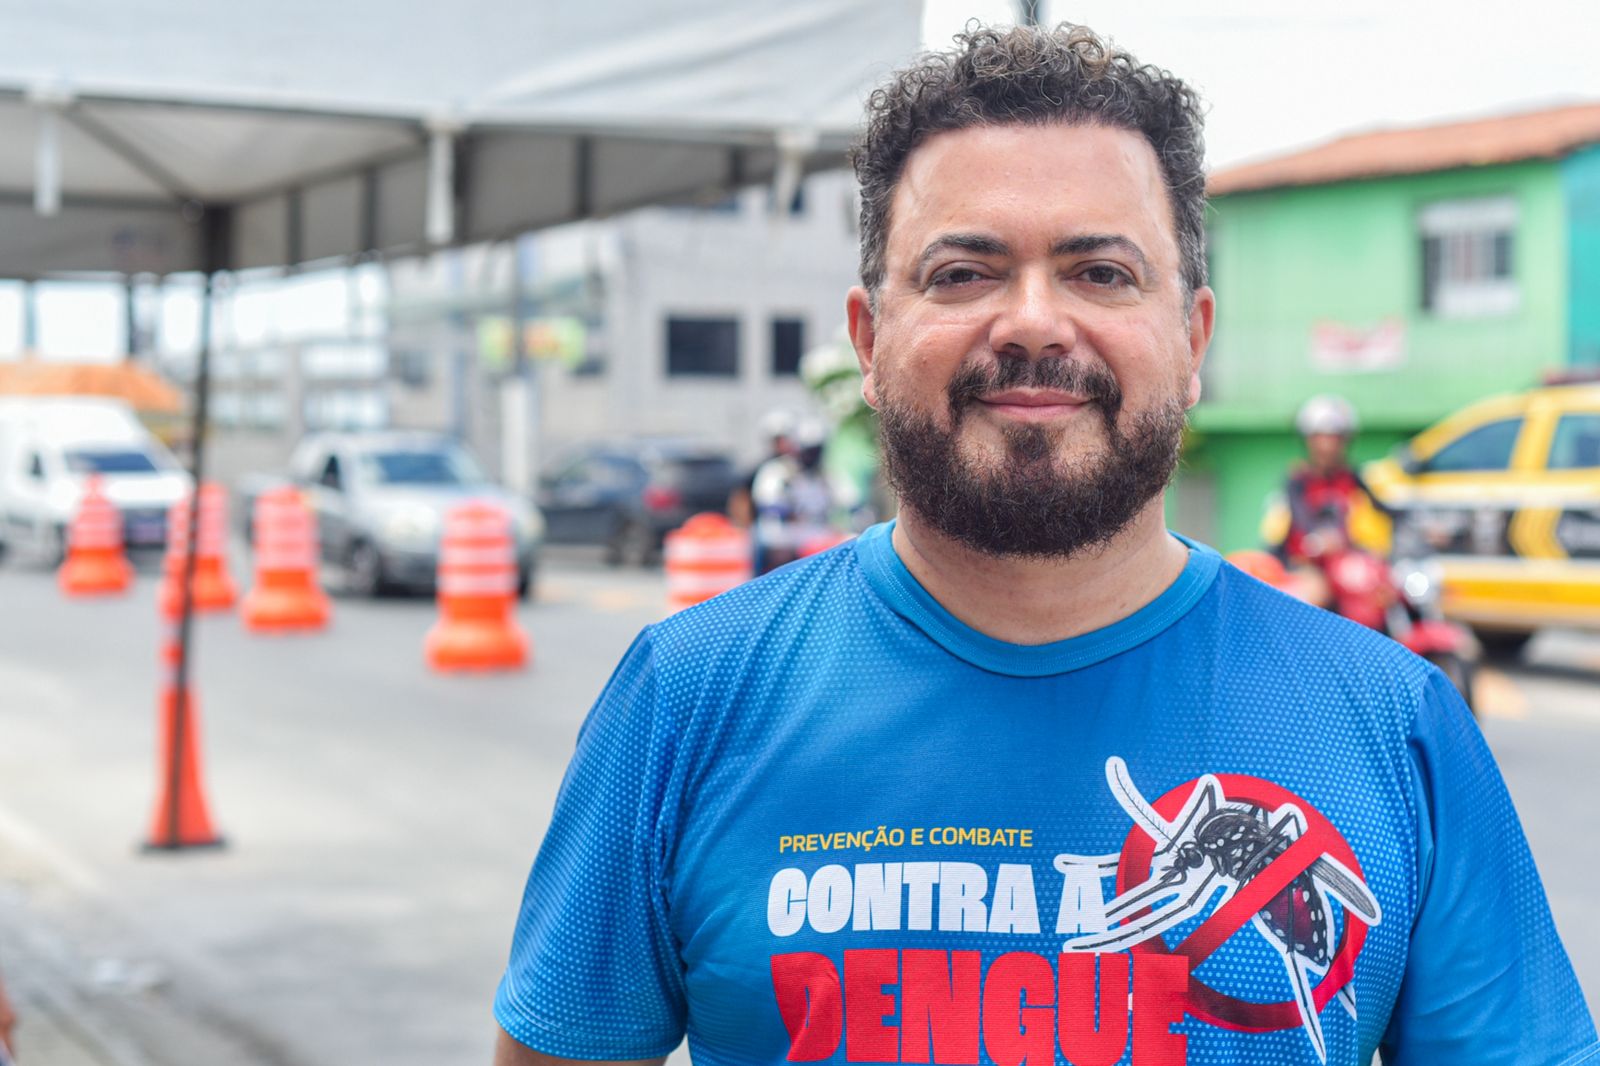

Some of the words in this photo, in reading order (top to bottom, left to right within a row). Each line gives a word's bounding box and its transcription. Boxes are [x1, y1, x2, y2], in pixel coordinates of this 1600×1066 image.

[779, 825, 905, 853] PREVENÇÃO
[911, 828, 925, 846] E
[929, 827, 1033, 847] COMBATE
[767, 861, 1041, 937] CONTRA
[1055, 863, 1106, 934] A
[770, 948, 1189, 1066] DENGUE
